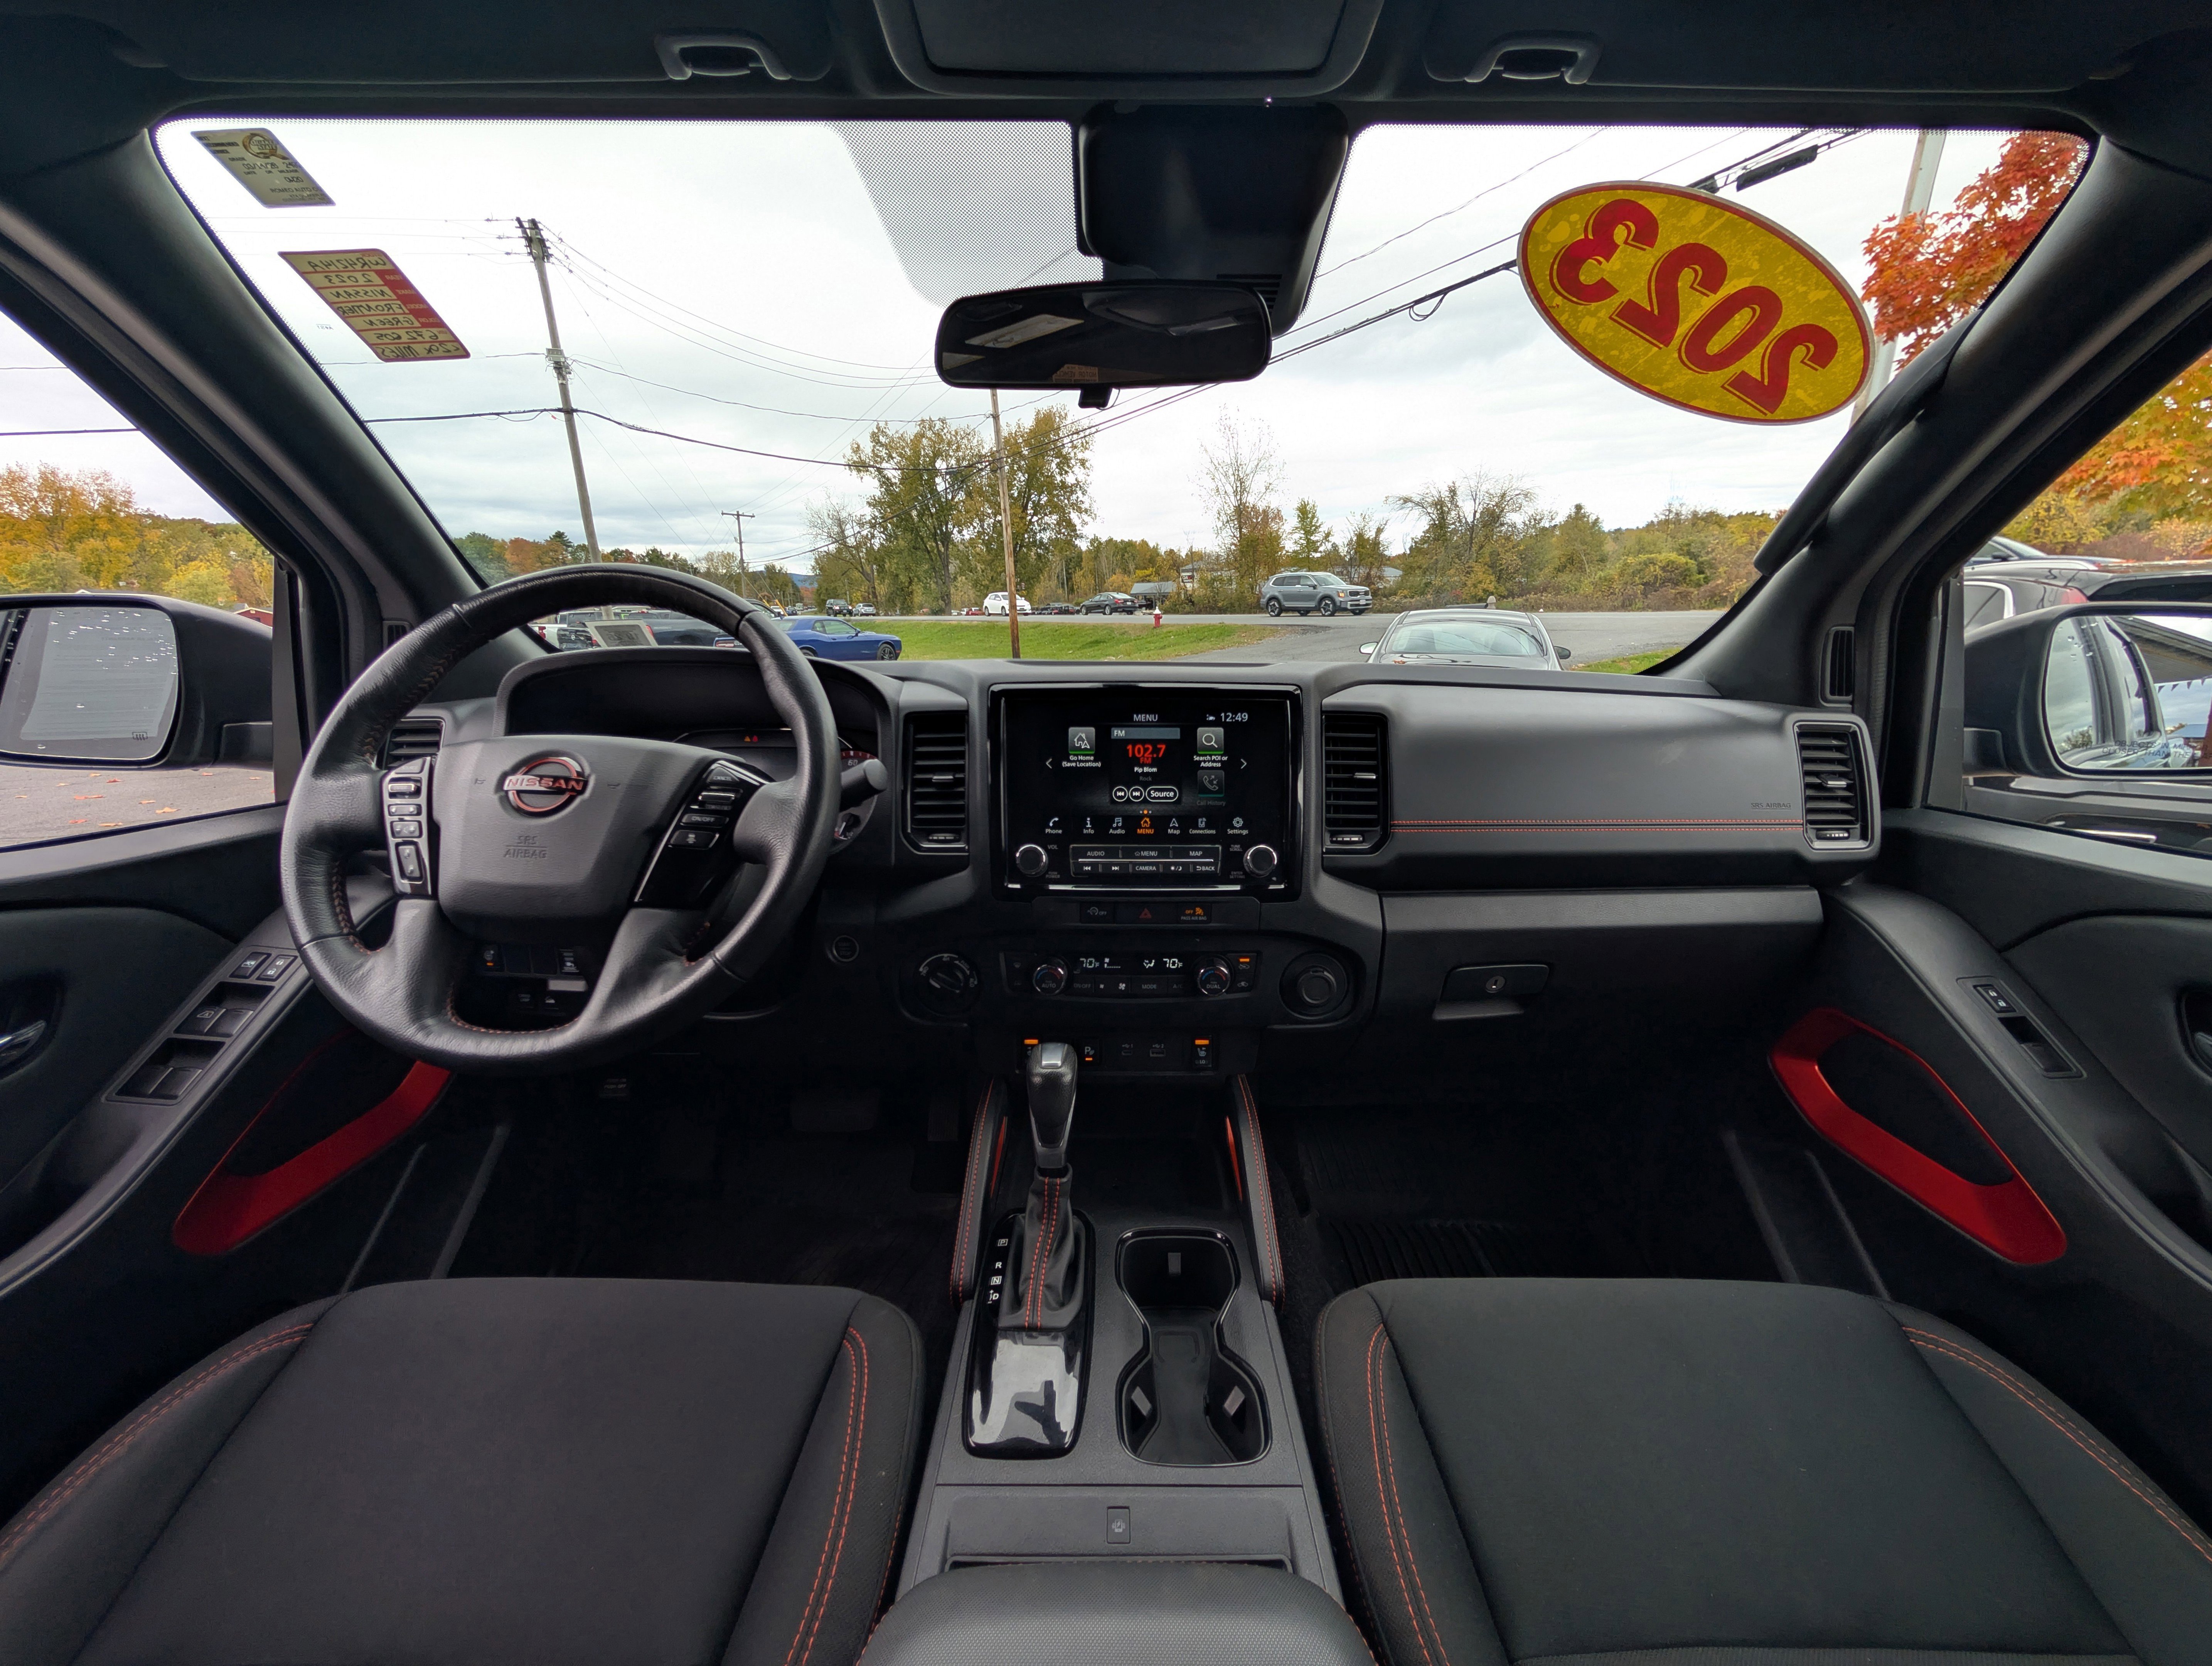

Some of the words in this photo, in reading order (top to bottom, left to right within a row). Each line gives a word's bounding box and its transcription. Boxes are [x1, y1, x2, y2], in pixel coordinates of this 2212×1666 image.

[1221, 713, 1248, 722] 12:49
[1126, 744, 1166, 758] 102.7
[506, 776, 584, 791] NISSAN
[503, 848, 548, 859] AIRBAG
